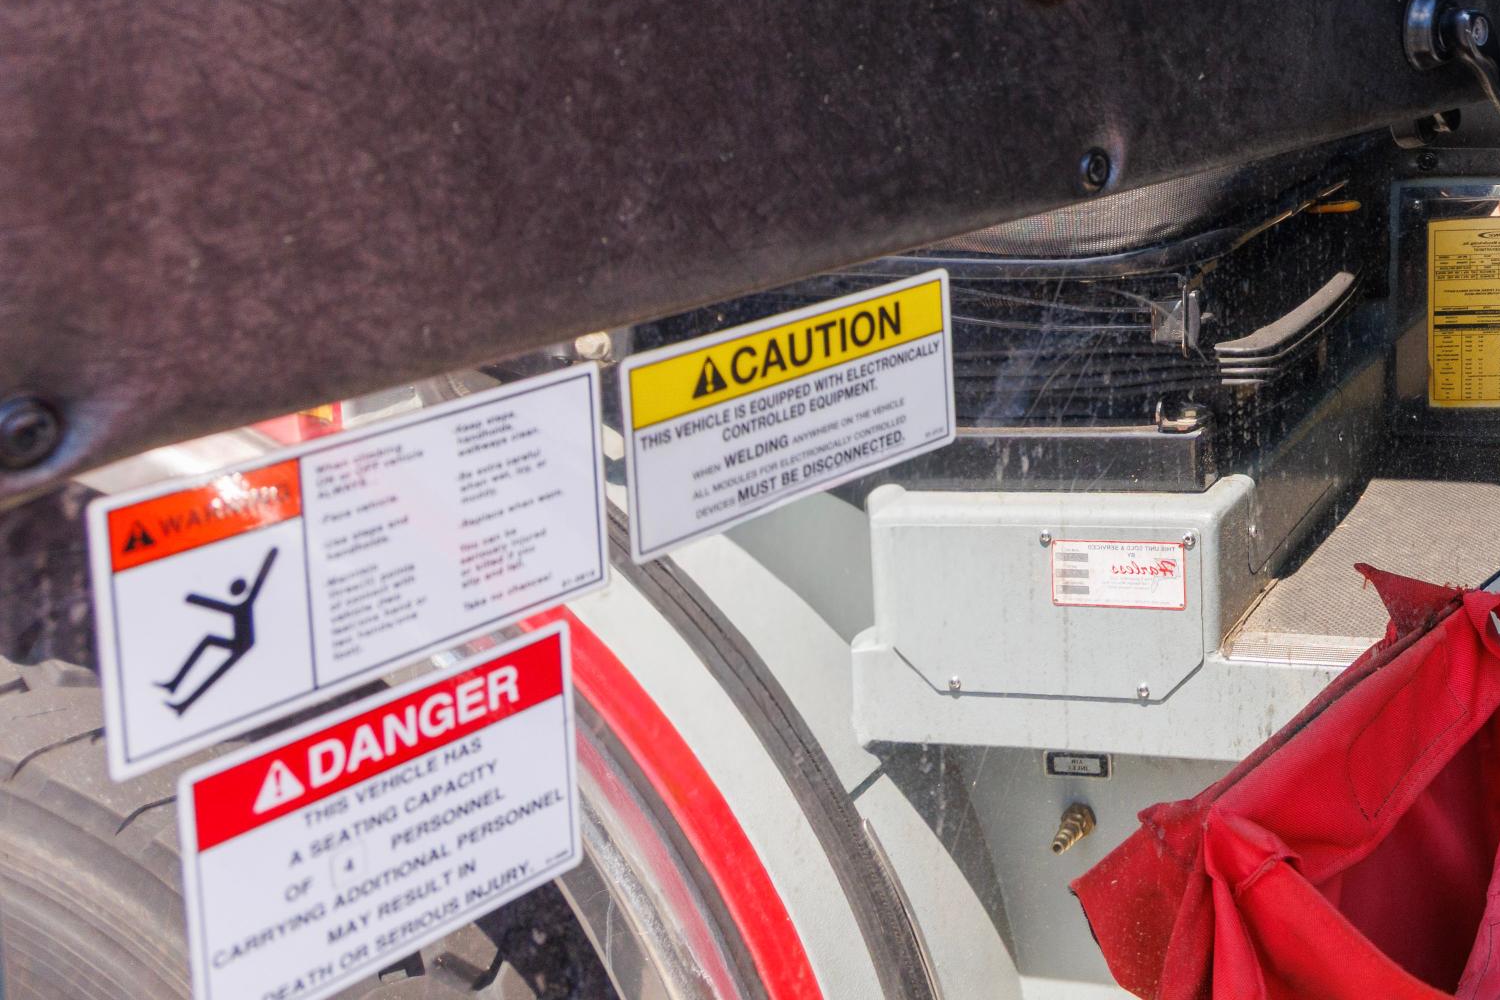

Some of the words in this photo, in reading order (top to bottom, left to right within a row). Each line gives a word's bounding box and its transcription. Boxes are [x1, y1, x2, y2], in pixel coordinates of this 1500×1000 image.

[729, 300, 901, 388] CAUTION
[640, 427, 671, 452] THIS
[675, 408, 730, 440] VEHICLE
[734, 403, 745, 420] IS
[749, 381, 810, 415] EQUIPPED
[814, 371, 842, 393] WITH
[846, 339, 939, 382] ELECTRONICALLY
[693, 463, 720, 481] WHEN
[724, 433, 788, 469] WELDING
[791, 420, 839, 445] ANYWHERE
[841, 415, 853, 427] ON
[855, 409, 869, 422] THE
[872, 397, 904, 416] VEHICLE
[722, 401, 805, 443] CONTROLLED
[809, 377, 878, 413] EQUIPMENT.
[693, 486, 709, 501] ALL
[712, 469, 757, 493] MODULES
[759, 461, 777, 476] FOR
[779, 434, 851, 469] ELECTRONICALLY
[854, 414, 906, 441] CONTROLLED
[696, 496, 734, 520] DEVICES
[737, 477, 775, 504] MUST
[781, 469, 798, 487] BE
[802, 428, 905, 479] DISCONNECTED.
[307, 660, 519, 791] DANGER
[288, 847, 302, 869] A
[309, 804, 397, 859] SEATING
[404, 758, 497, 815] CAPACITY
[304, 795, 348, 829] THIS
[356, 755, 437, 805] VEHICLE
[443, 736, 482, 766] HAS
[212, 900, 325, 971] CARRYING
[333, 841, 448, 912] ADDITIONAL
[457, 785, 563, 851] PERSONNEL
[284, 875, 313, 904] OF
[343, 857, 353, 874] 4
[390, 783, 505, 851] PERSONNEL
[263, 960, 333, 1000] DEATH
[339, 941, 370, 971] OR
[375, 893, 463, 952] SERIOUS
[465, 857, 533, 906] INJURY.
[327, 910, 371, 946] MAY
[377, 869, 452, 921] RESULT
[458, 857, 477, 880] IN
